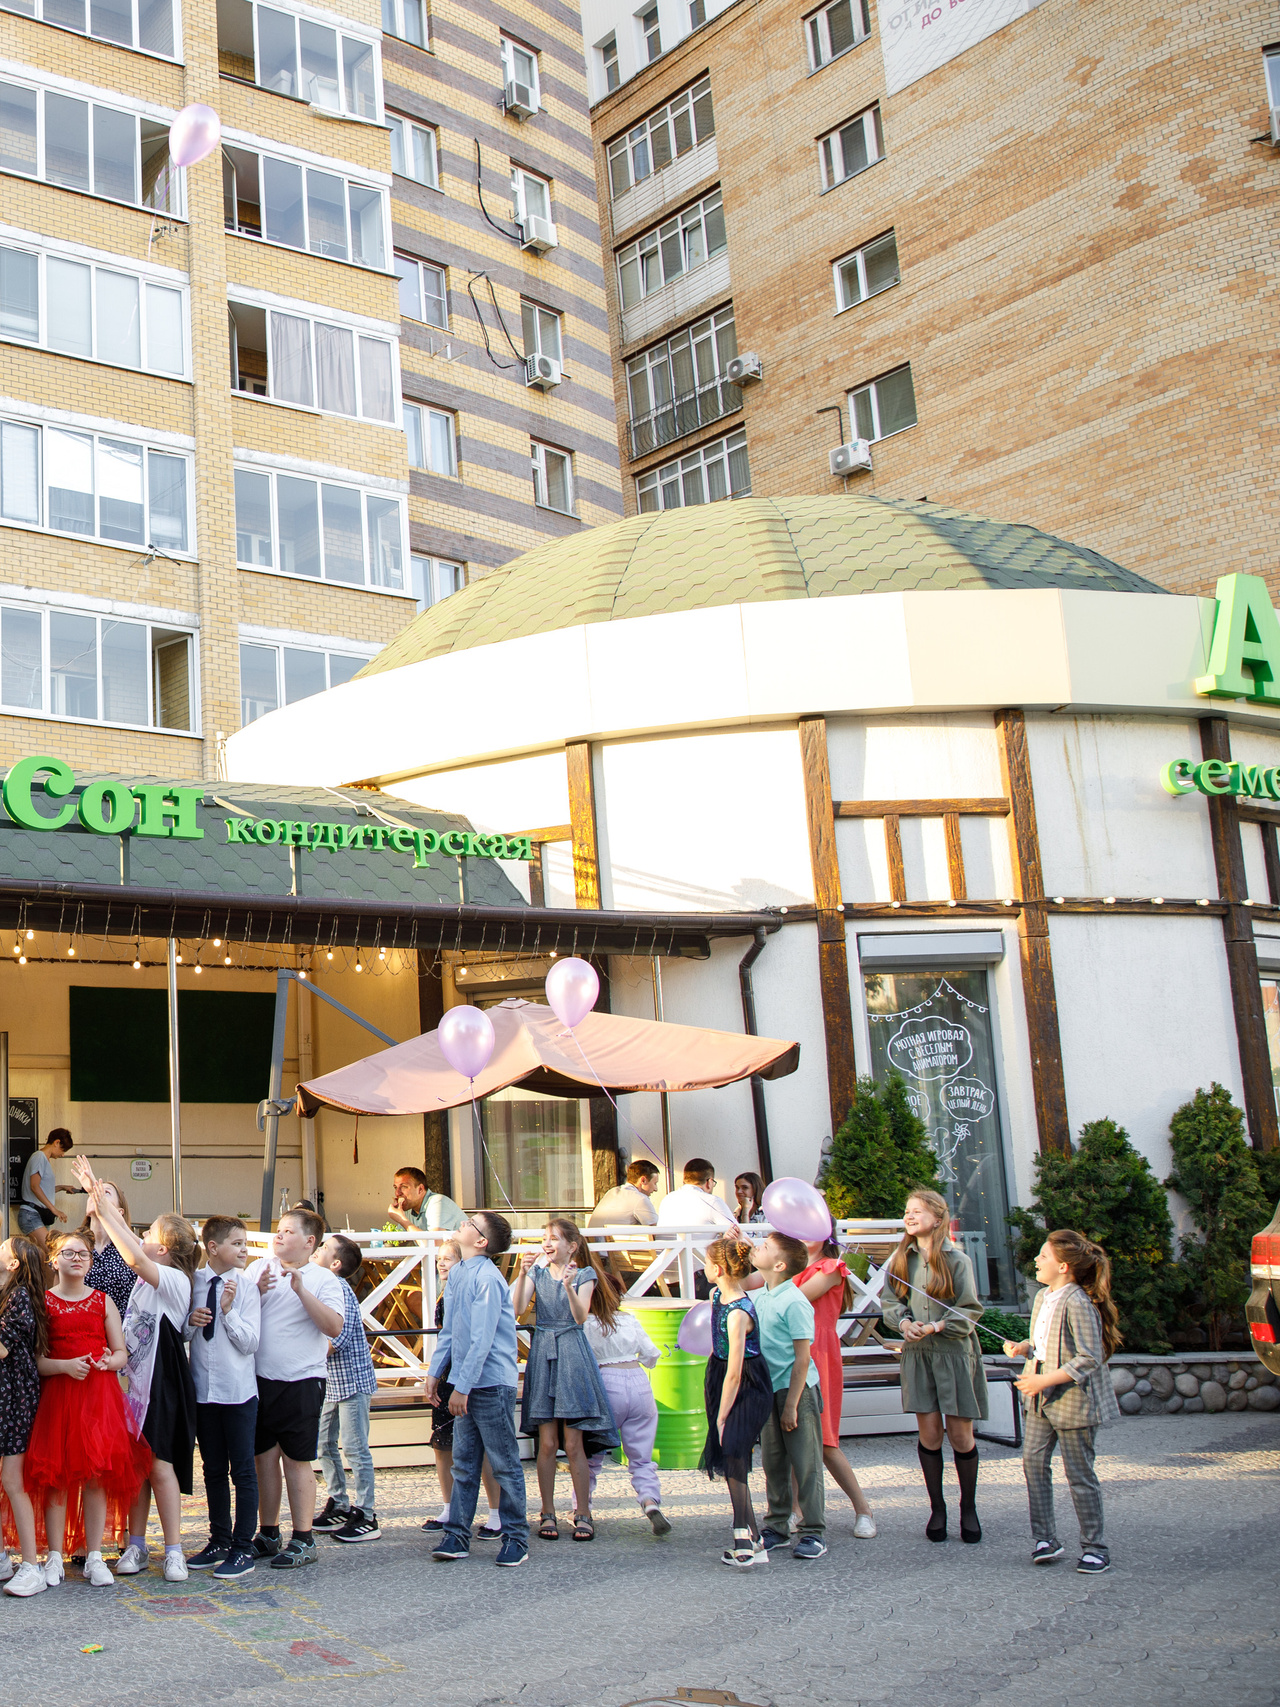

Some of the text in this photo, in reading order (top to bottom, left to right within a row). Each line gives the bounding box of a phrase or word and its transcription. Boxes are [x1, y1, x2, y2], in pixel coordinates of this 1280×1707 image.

[921, 7, 942, 30] ДО
[224, 816, 535, 869] кондитерская
[893, 1029, 964, 1052] УЮТНАЯ ИГРОВАЯ
[908, 1041, 954, 1060] С ВЕСЕЛЫМ
[912, 1054, 958, 1072] АНИМАТОРОМ
[948, 1085, 987, 1100] ЗАВТРАК
[947, 1096, 987, 1114] ЦЕЛЫЙ ДЕНЬ
